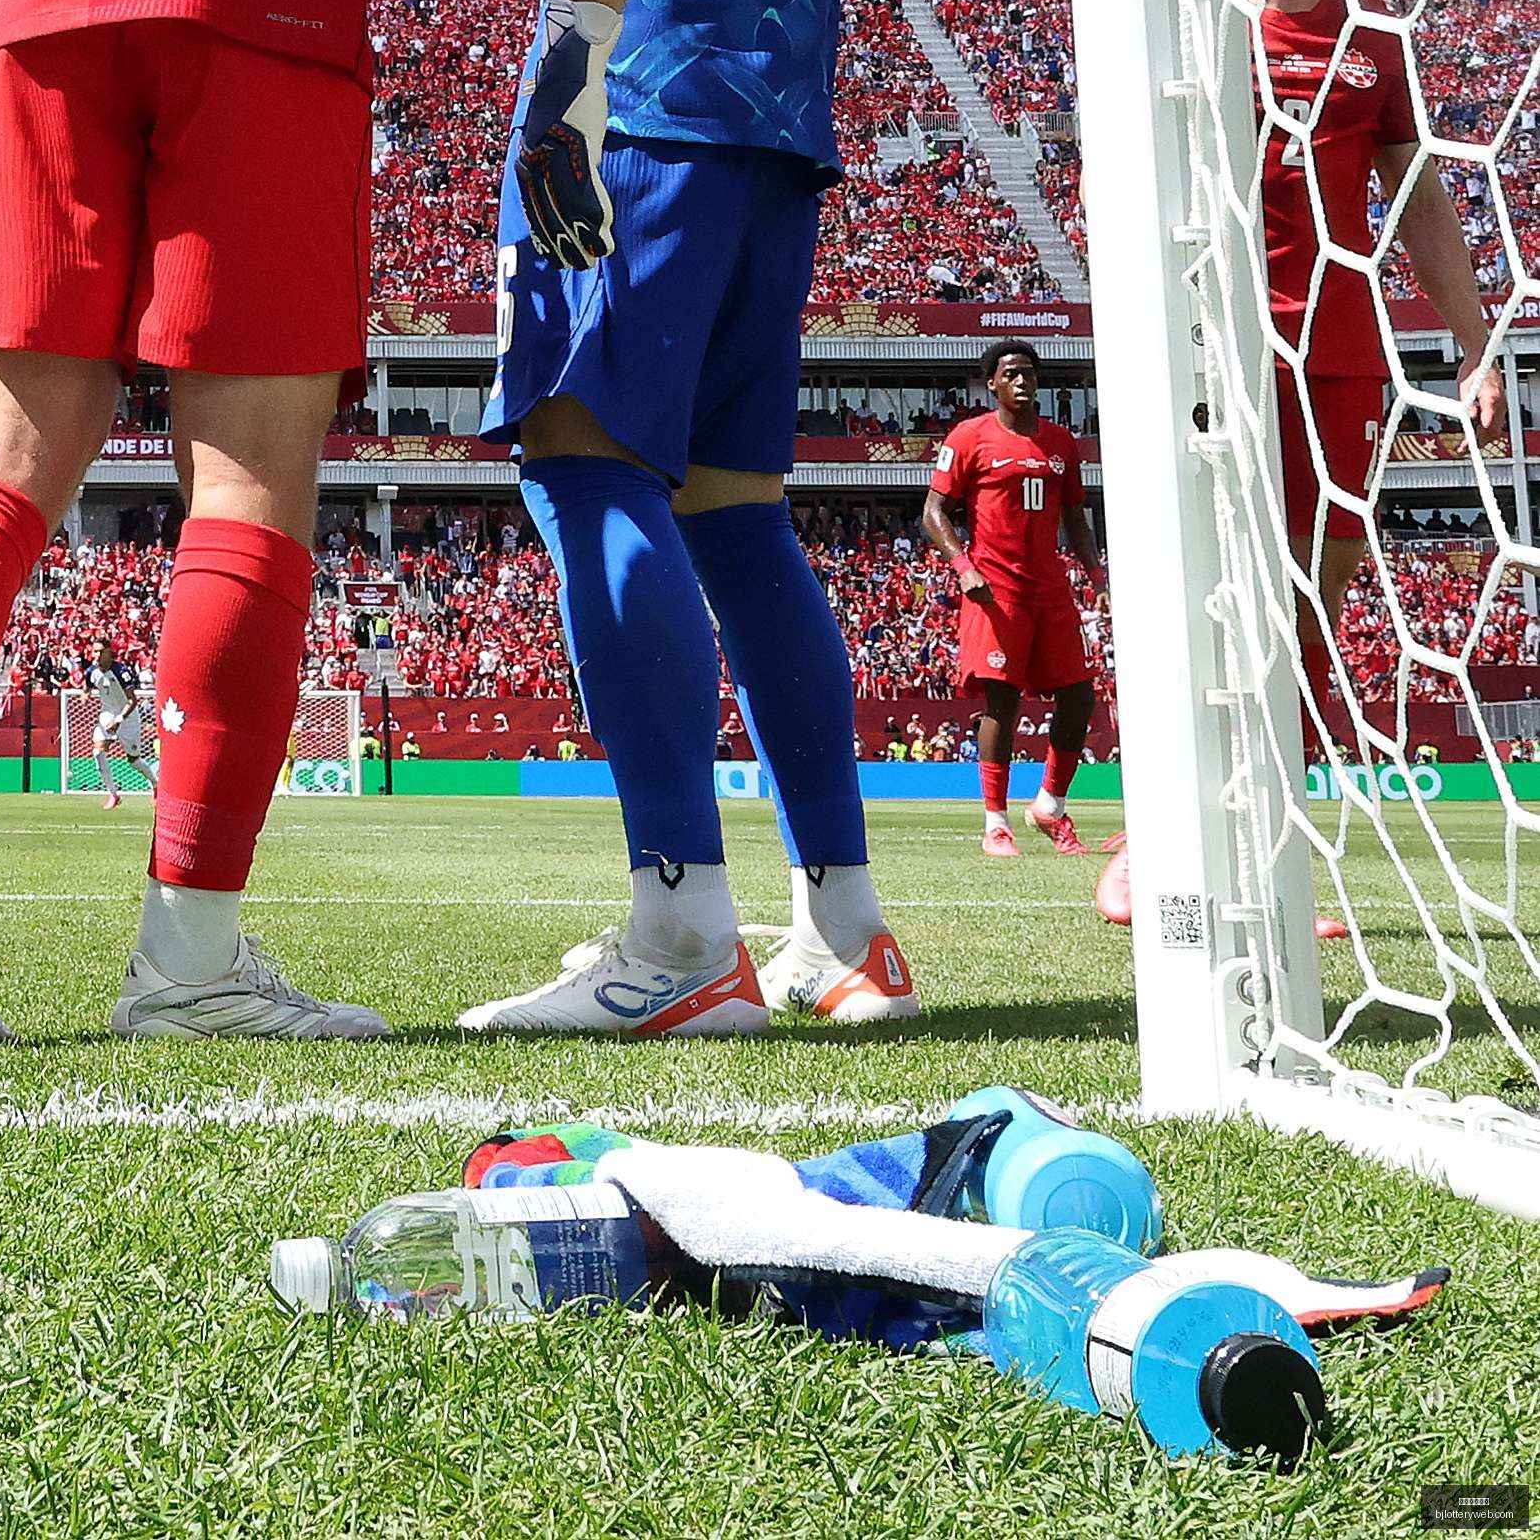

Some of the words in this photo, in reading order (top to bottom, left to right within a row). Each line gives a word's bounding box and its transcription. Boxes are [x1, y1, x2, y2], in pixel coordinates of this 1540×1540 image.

[979, 312, 1070, 329] #FIFAWorldCup
[100, 439, 137, 454] NDE
[140, 439, 165, 454] DE
[1022, 477, 1044, 511] 10
[1306, 765, 1443, 800] amco
